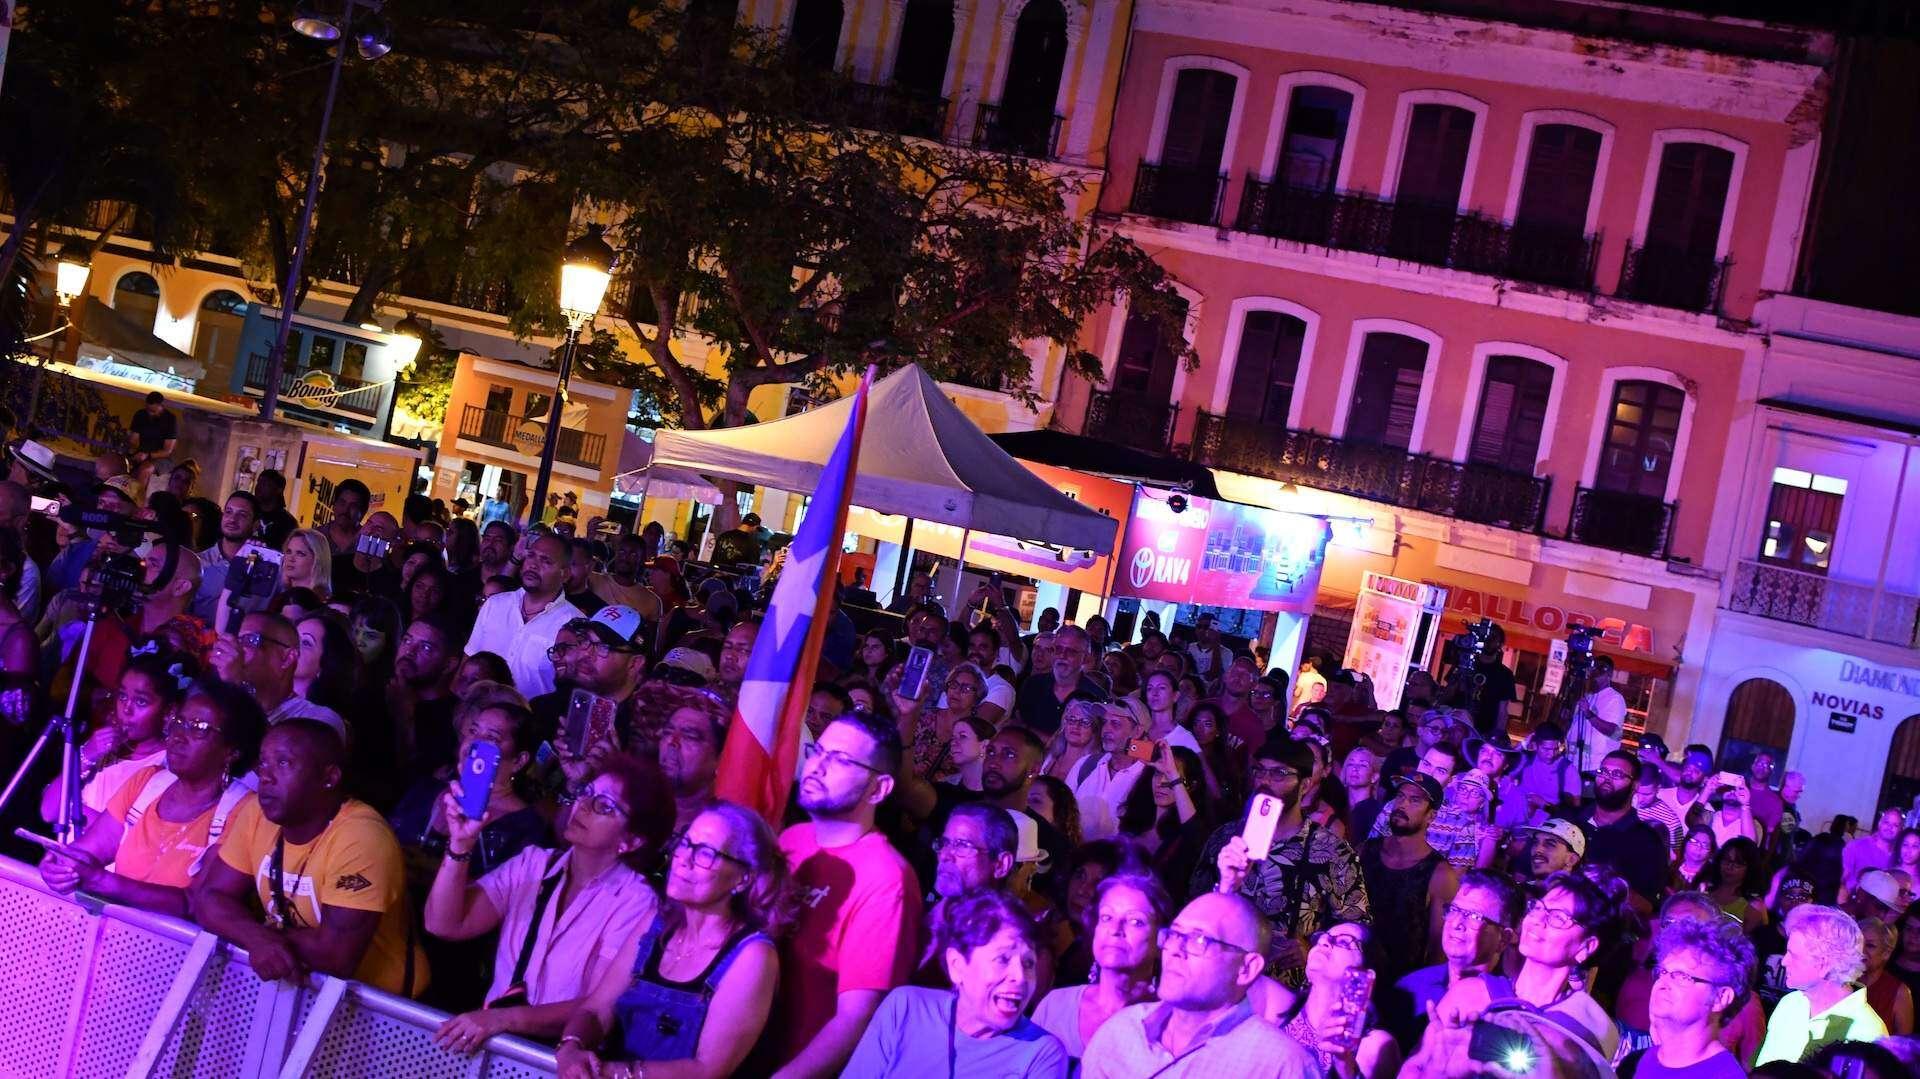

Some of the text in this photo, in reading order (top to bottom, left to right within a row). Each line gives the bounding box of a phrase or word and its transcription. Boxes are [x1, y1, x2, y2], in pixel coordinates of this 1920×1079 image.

[288, 379, 338, 407] Bounty
[515, 430, 547, 444] MEDALLA
[1153, 555, 1192, 586] RAV4
[1812, 691, 1884, 720] NOVIAS
